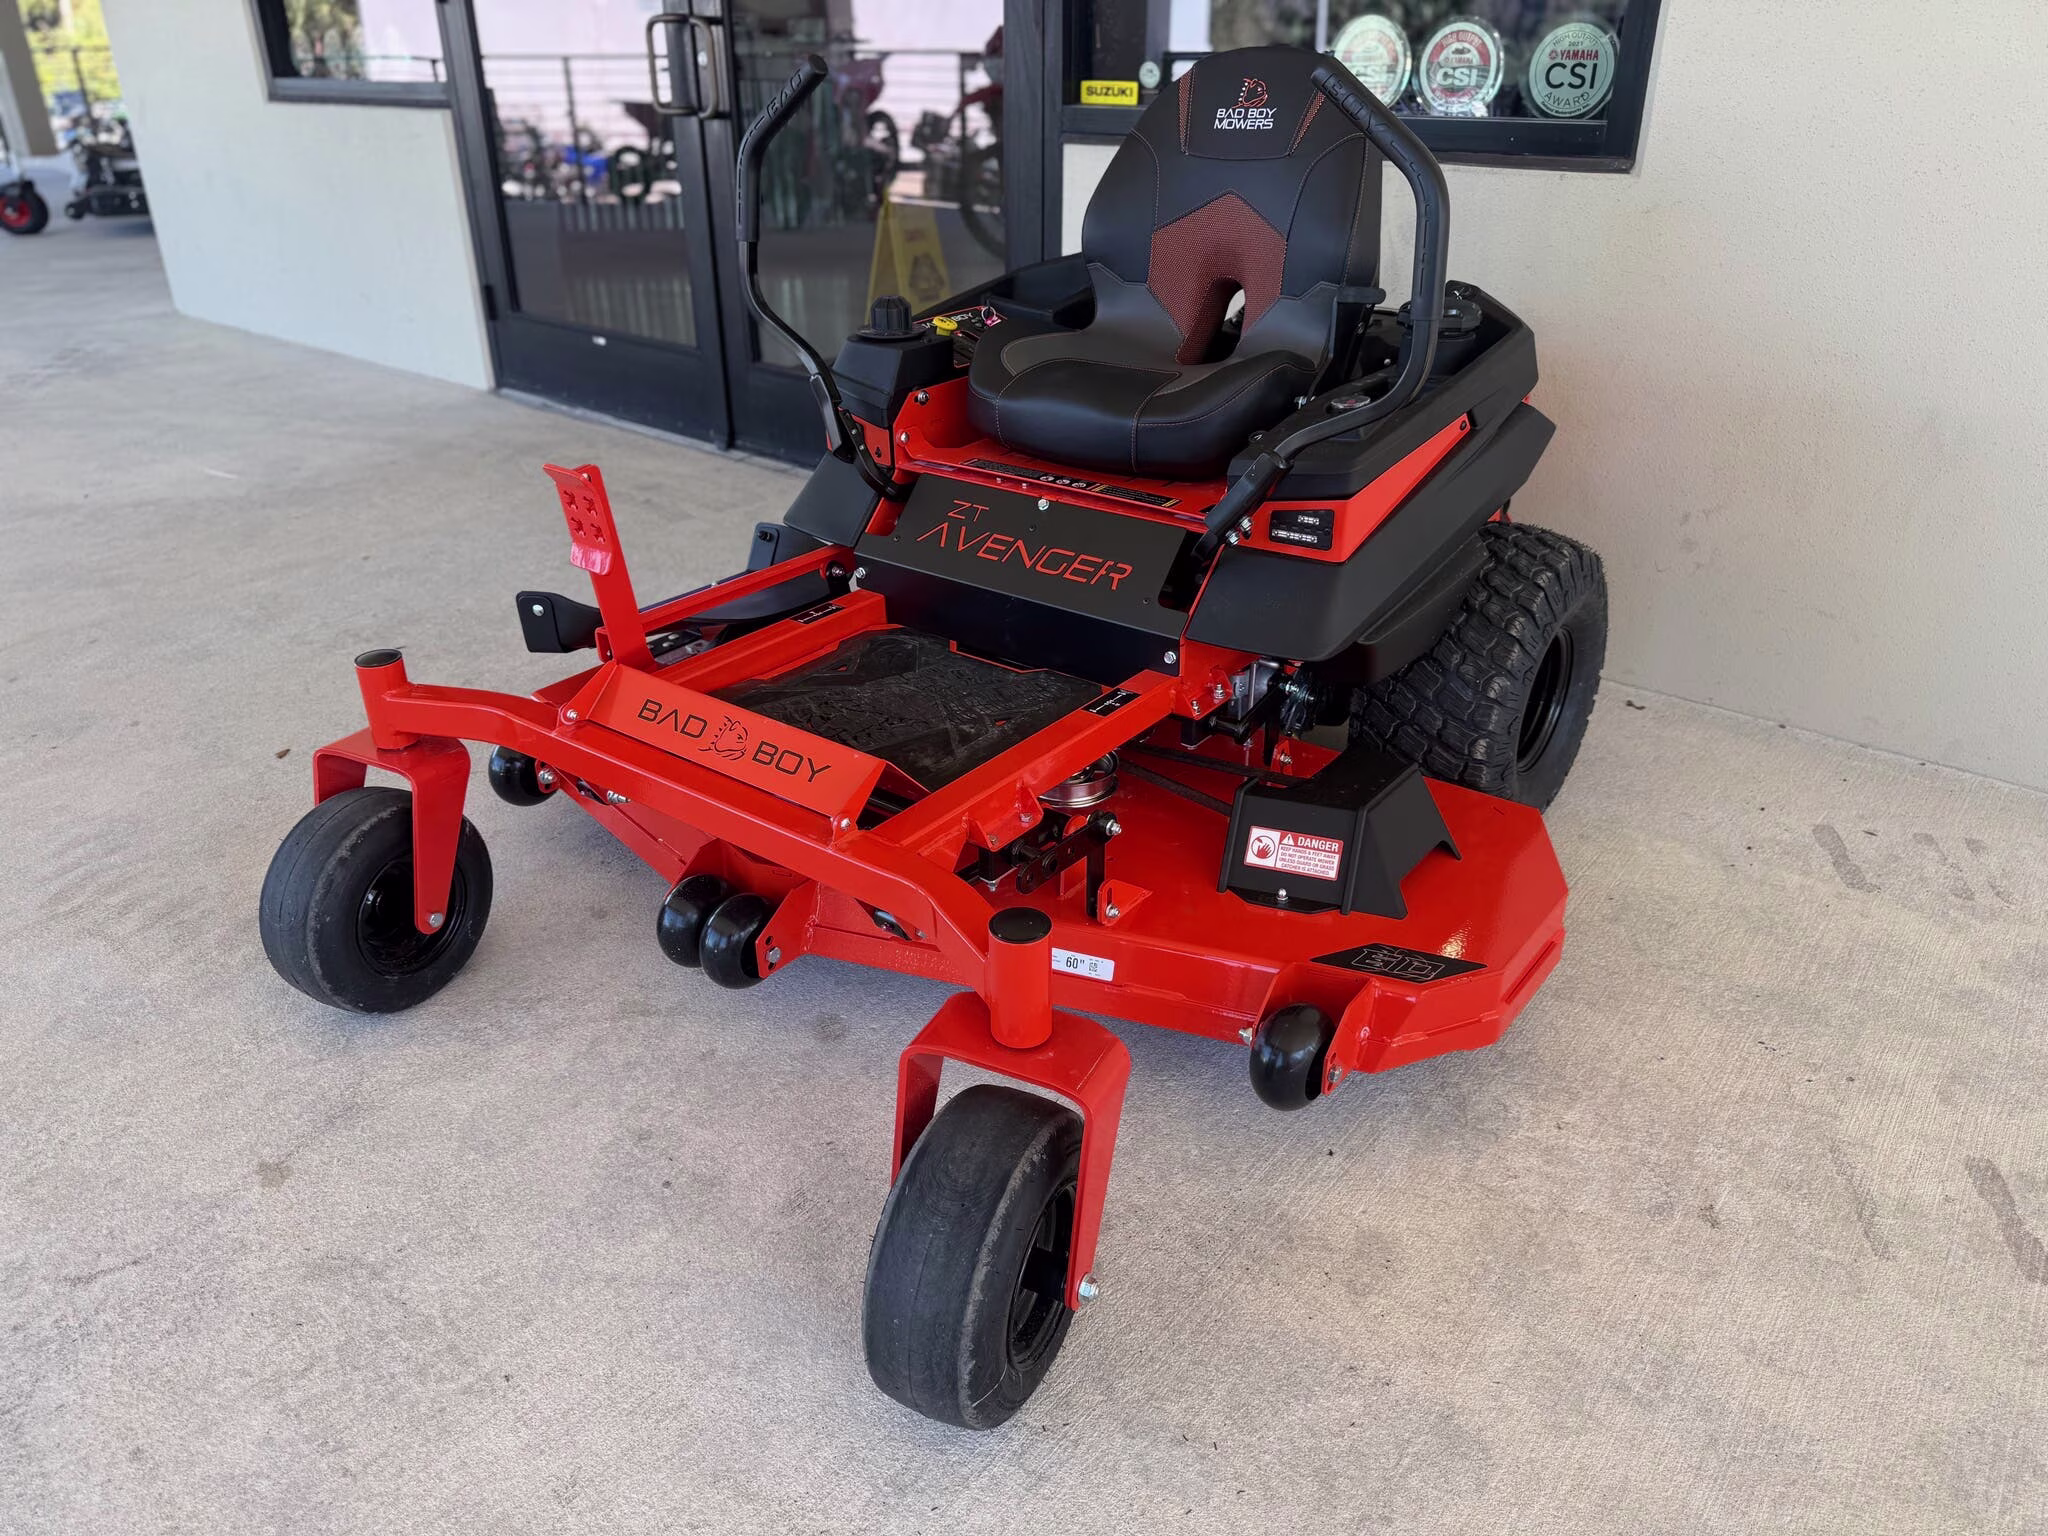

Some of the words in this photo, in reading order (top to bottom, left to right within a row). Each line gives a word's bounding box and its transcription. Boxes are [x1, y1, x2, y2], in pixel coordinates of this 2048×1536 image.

[1553, 34, 1570, 47] HIGH
[1571, 31, 1598, 46] OUTPUT
[1560, 49, 1599, 60] YAMAHA
[1437, 66, 1478, 86] CSI
[1545, 62, 1598, 89] CSI
[1086, 86, 1133, 97] SUZUKI
[1544, 92, 1590, 109] AWARD
[1216, 108, 1244, 118] BAD
[1247, 108, 1277, 118] BOY
[1213, 119, 1274, 130] MOWERS
[947, 500, 990, 522] ZT
[916, 522, 1133, 590] AVENGER
[637, 698, 708, 739] BAD
[752, 740, 832, 783] BOY
[1297, 836, 1339, 853] DANGER
[1066, 956, 1085, 969] 60"
